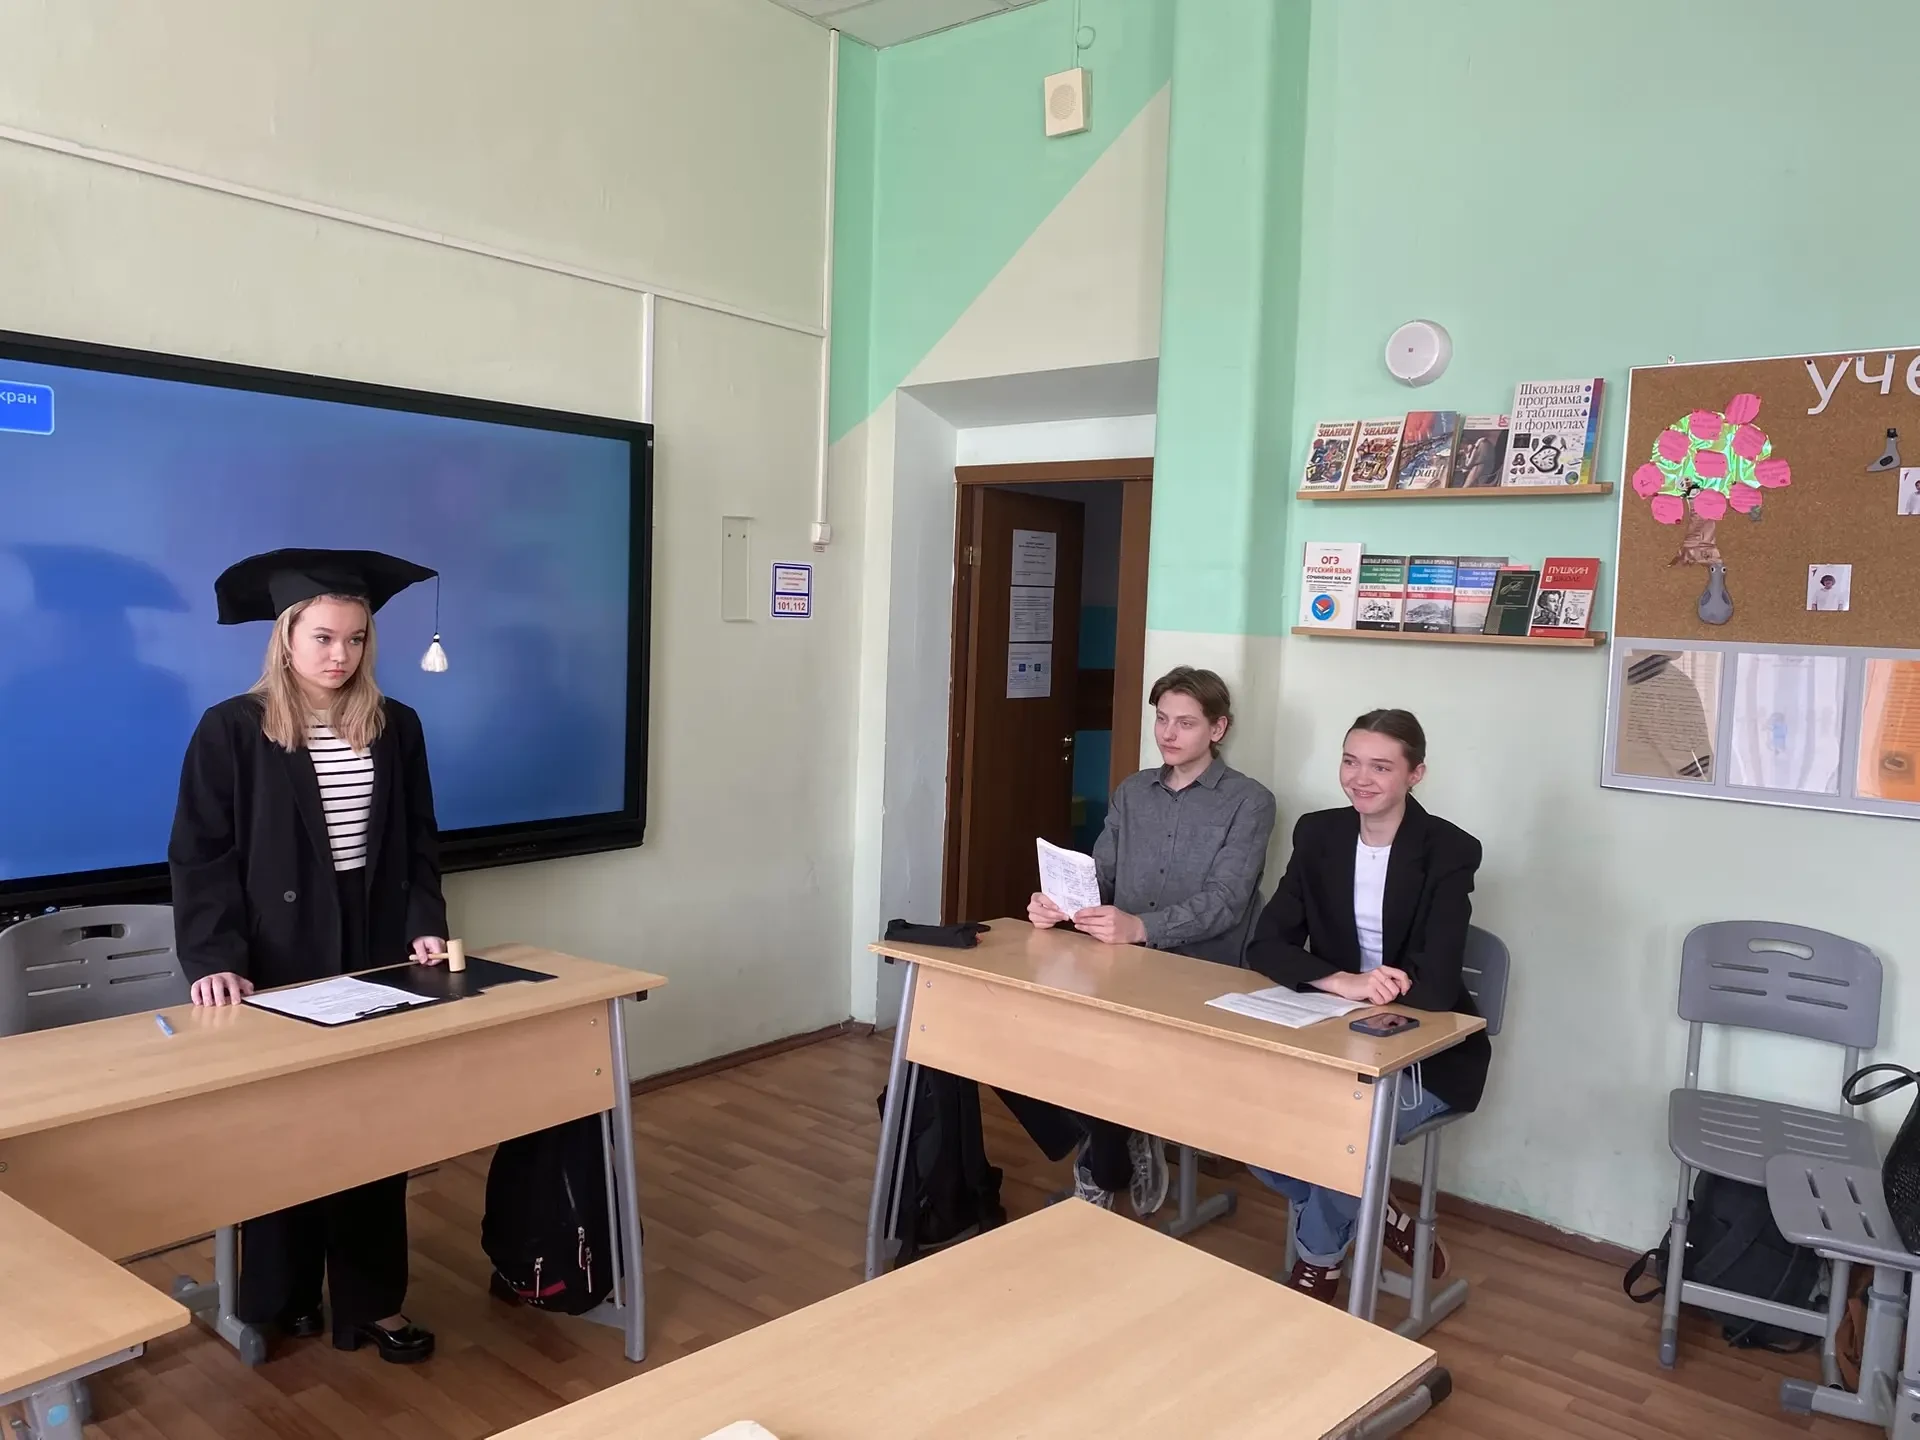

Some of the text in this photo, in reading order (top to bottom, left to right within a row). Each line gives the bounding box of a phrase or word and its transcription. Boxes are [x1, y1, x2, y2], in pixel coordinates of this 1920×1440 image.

[1520, 383, 1581, 395] Школьная
[1518, 395, 1582, 409] программа
[1516, 406, 1580, 418] в таблицах
[1515, 418, 1585, 433] и формулах
[1321, 556, 1340, 564] ОГЭ
[1547, 566, 1589, 575] ПУШКИН
